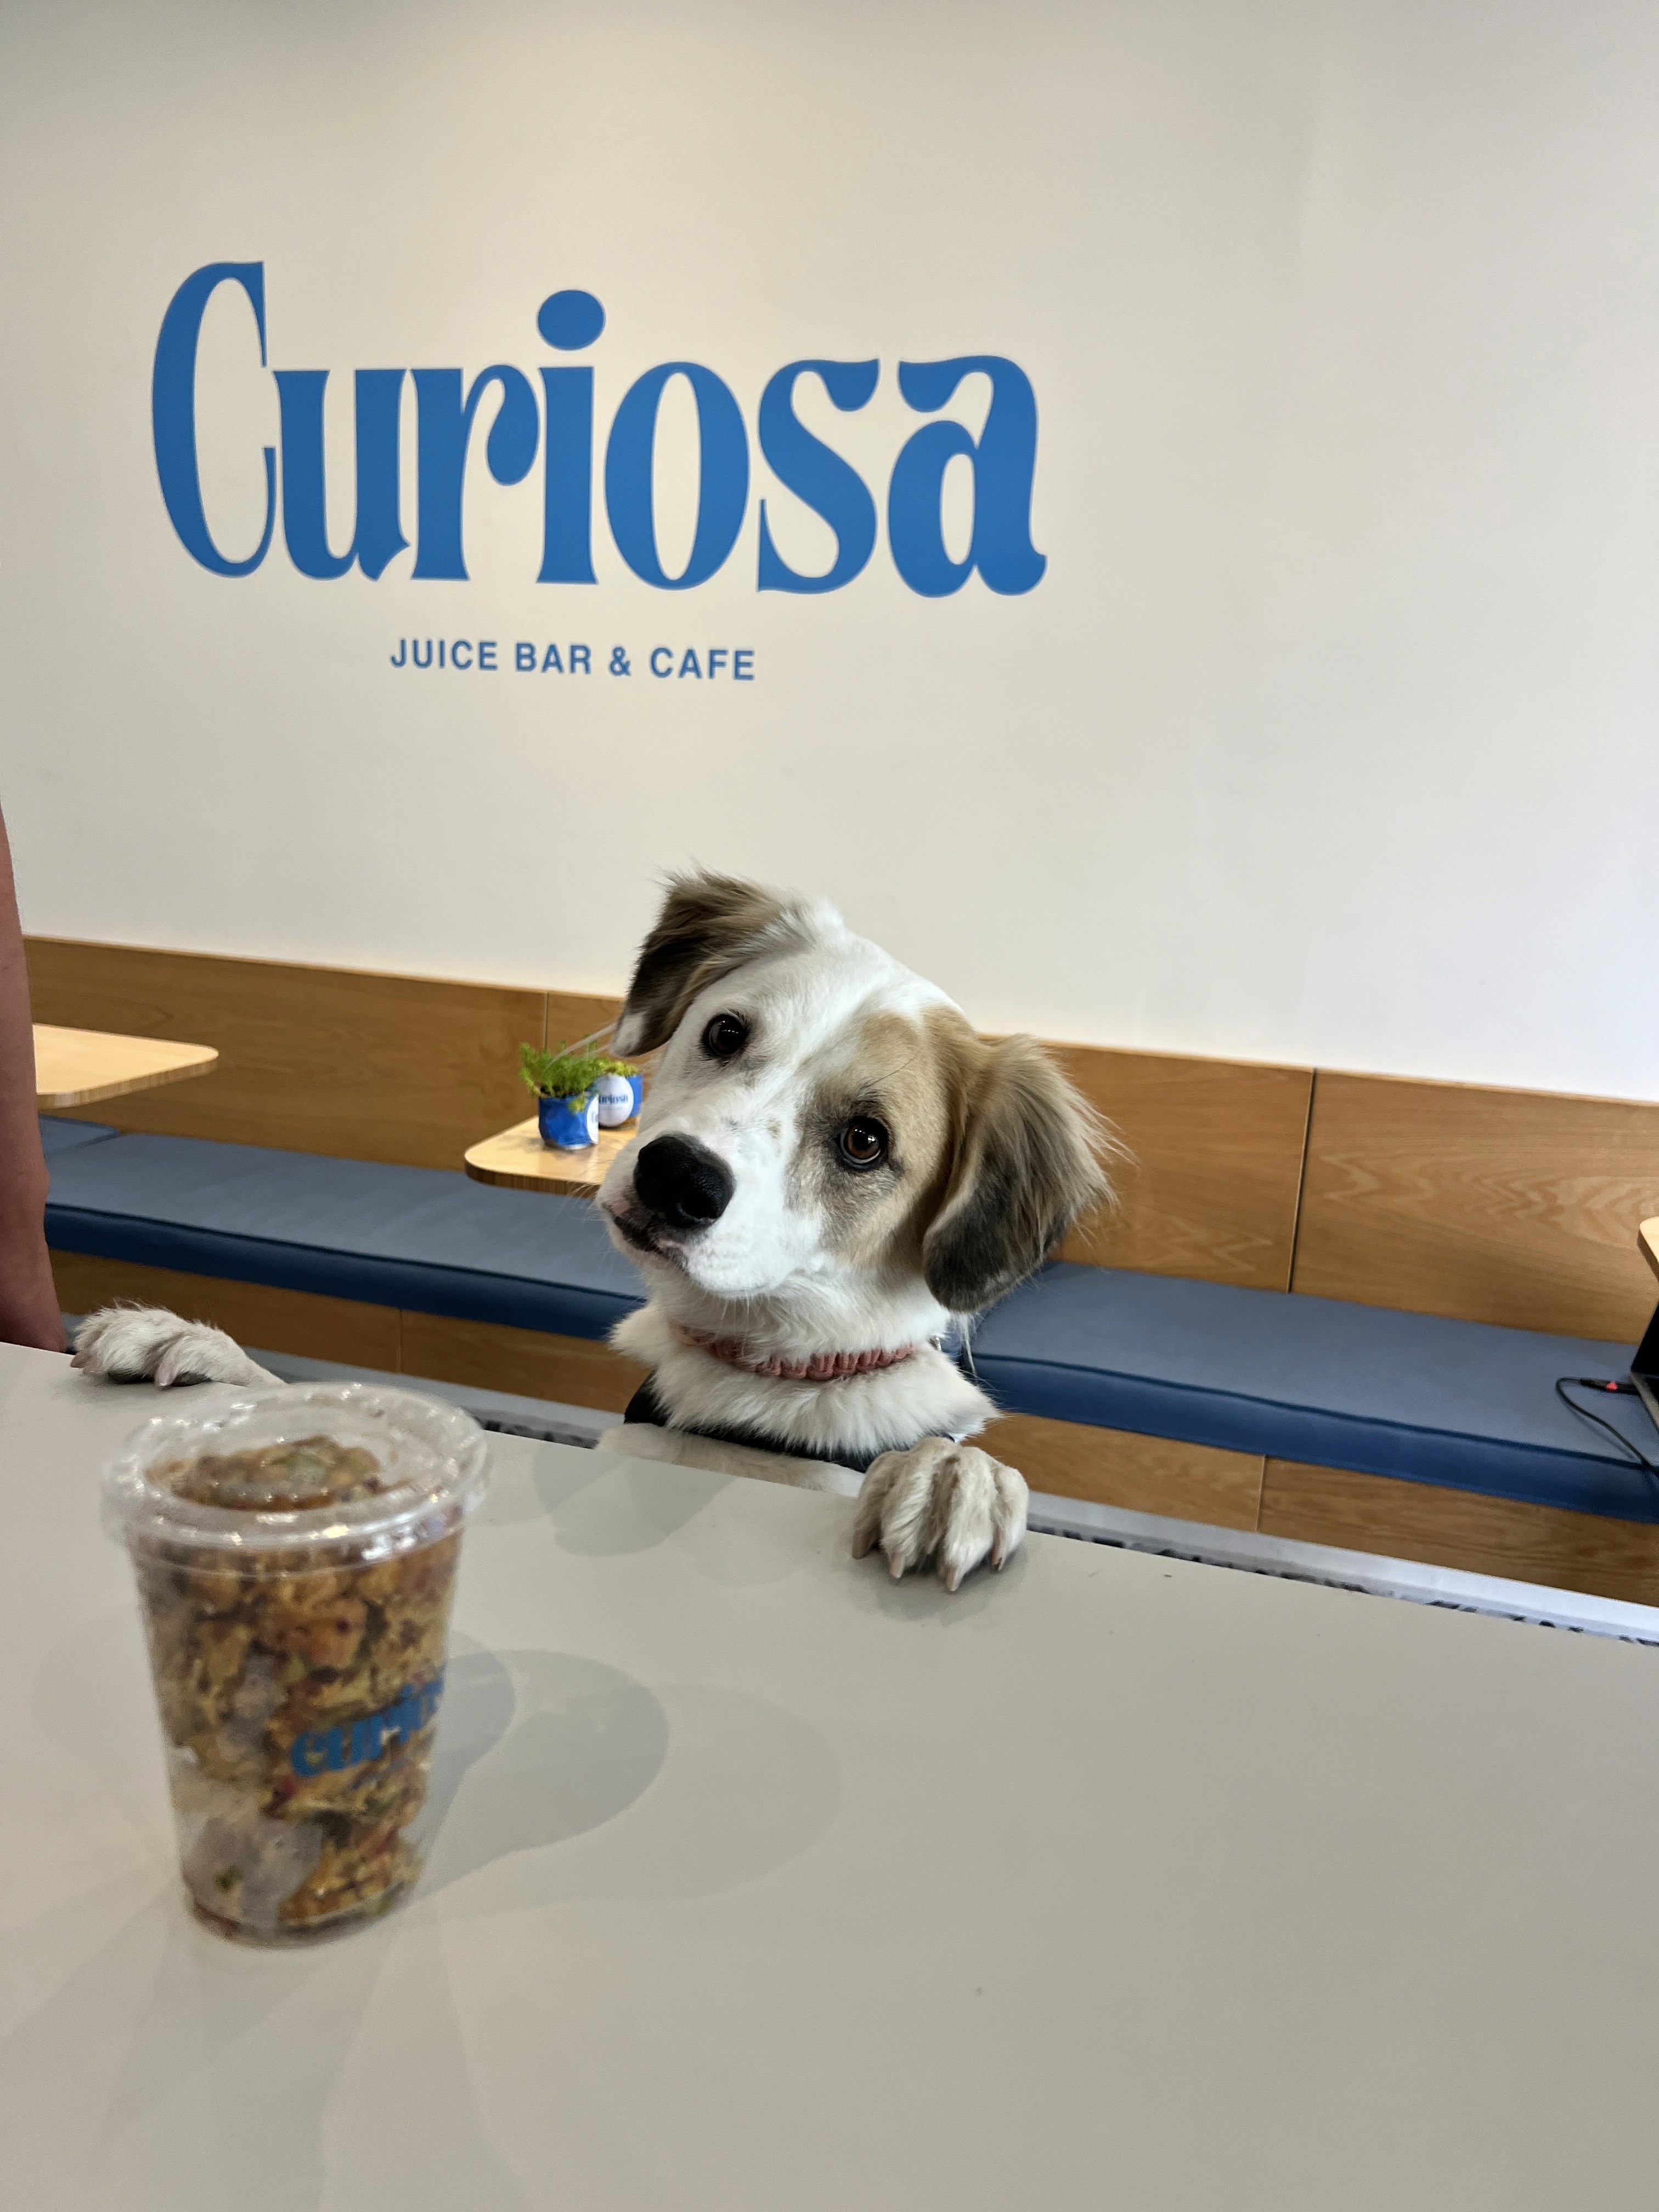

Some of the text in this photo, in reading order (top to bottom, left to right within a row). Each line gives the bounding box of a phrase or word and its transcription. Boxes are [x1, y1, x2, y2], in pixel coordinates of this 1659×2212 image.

[152, 261, 1047, 599] Curiosa
[391, 639, 754, 680] JUICE BAR & CAFE
